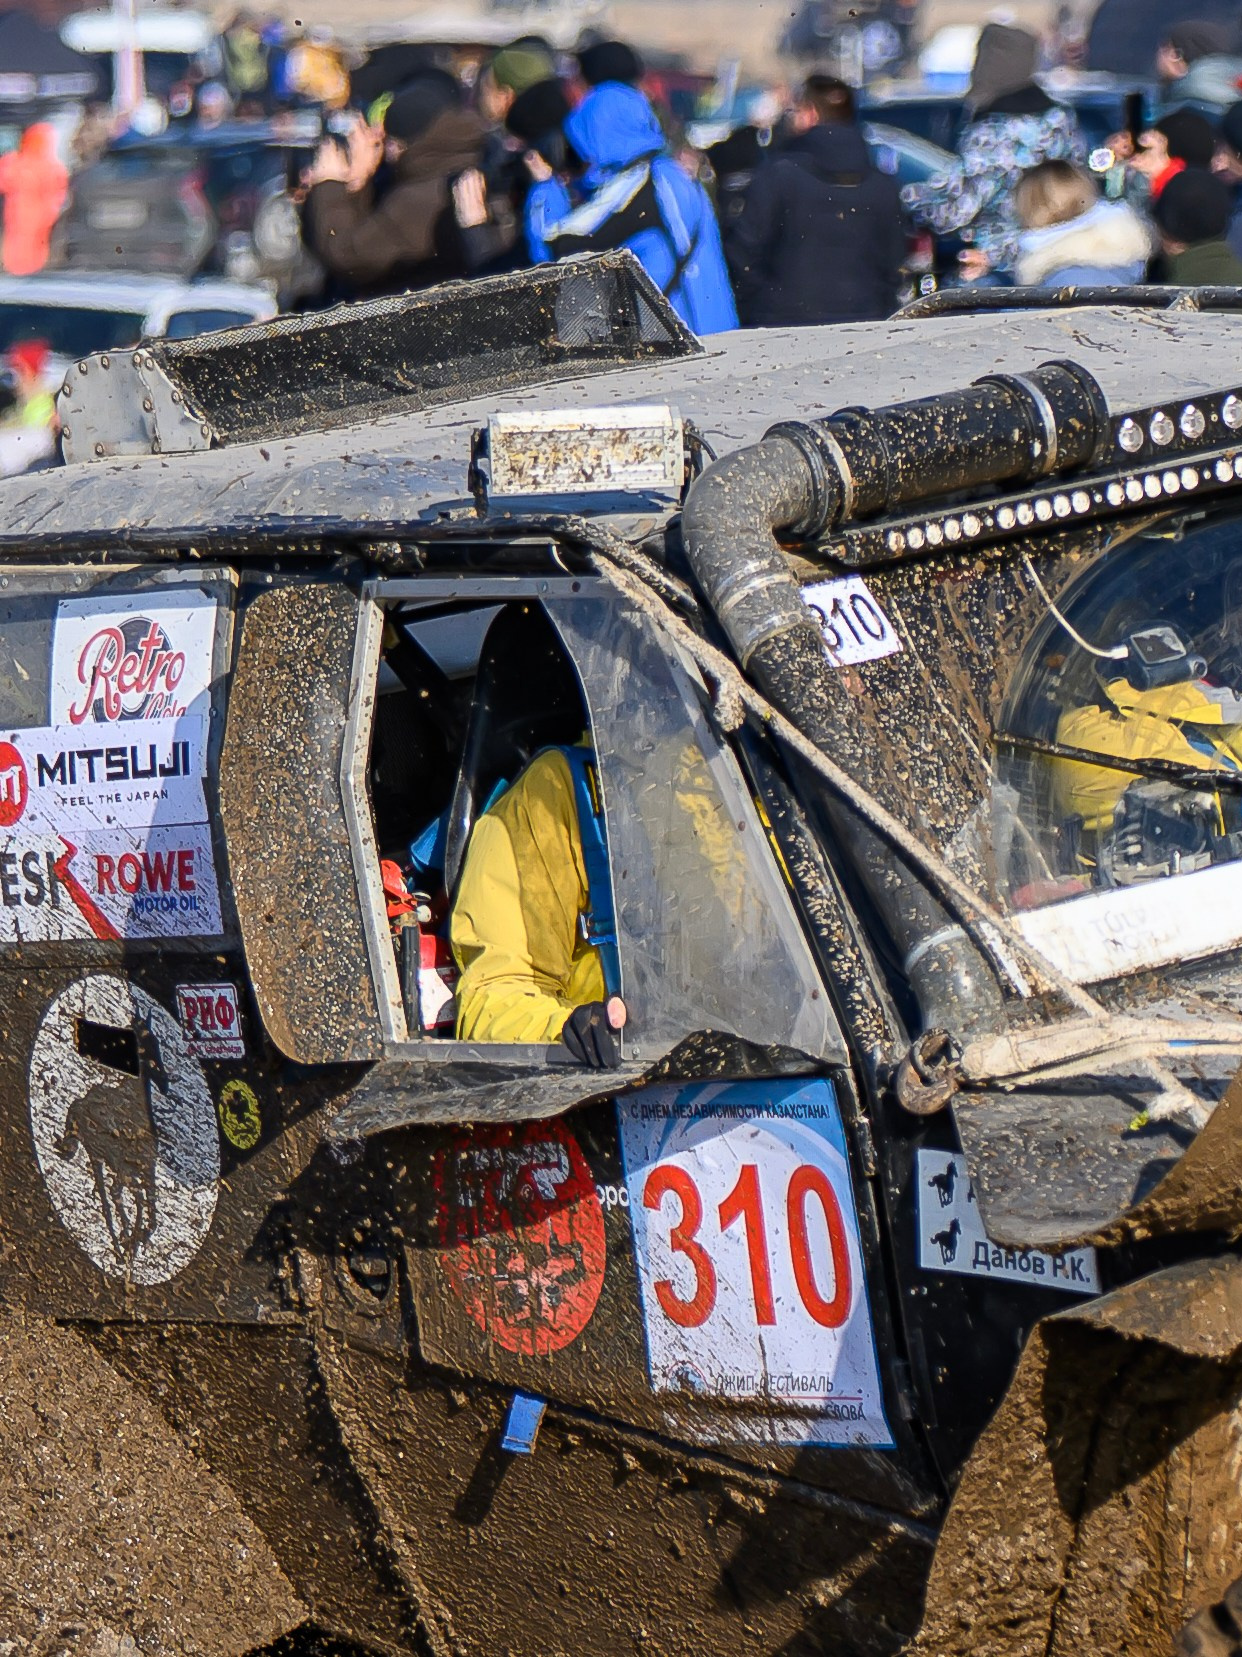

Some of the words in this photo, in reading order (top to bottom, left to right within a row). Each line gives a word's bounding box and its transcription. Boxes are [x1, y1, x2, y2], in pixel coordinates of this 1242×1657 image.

[808, 593, 887, 652] 310
[69, 621, 186, 726] Retro
[36, 741, 190, 787] MITSUJI
[61, 796, 94, 807] FEEL
[98, 792, 122, 804] THE
[126, 789, 169, 802] JAPAN
[97, 850, 196, 895] ROWE
[132, 895, 179, 913] MOTOR
[179, 894, 200, 911] OIL
[184, 994, 235, 1031] РИФ
[630, 1103, 639, 1120] С
[674, 1103, 763, 1120] НЕЗАВИСИМОСТИ
[764, 1103, 830, 1119] КАЗАХСТАНА!
[643, 1163, 853, 1329] 310
[972, 1240, 1046, 1275] Данов
